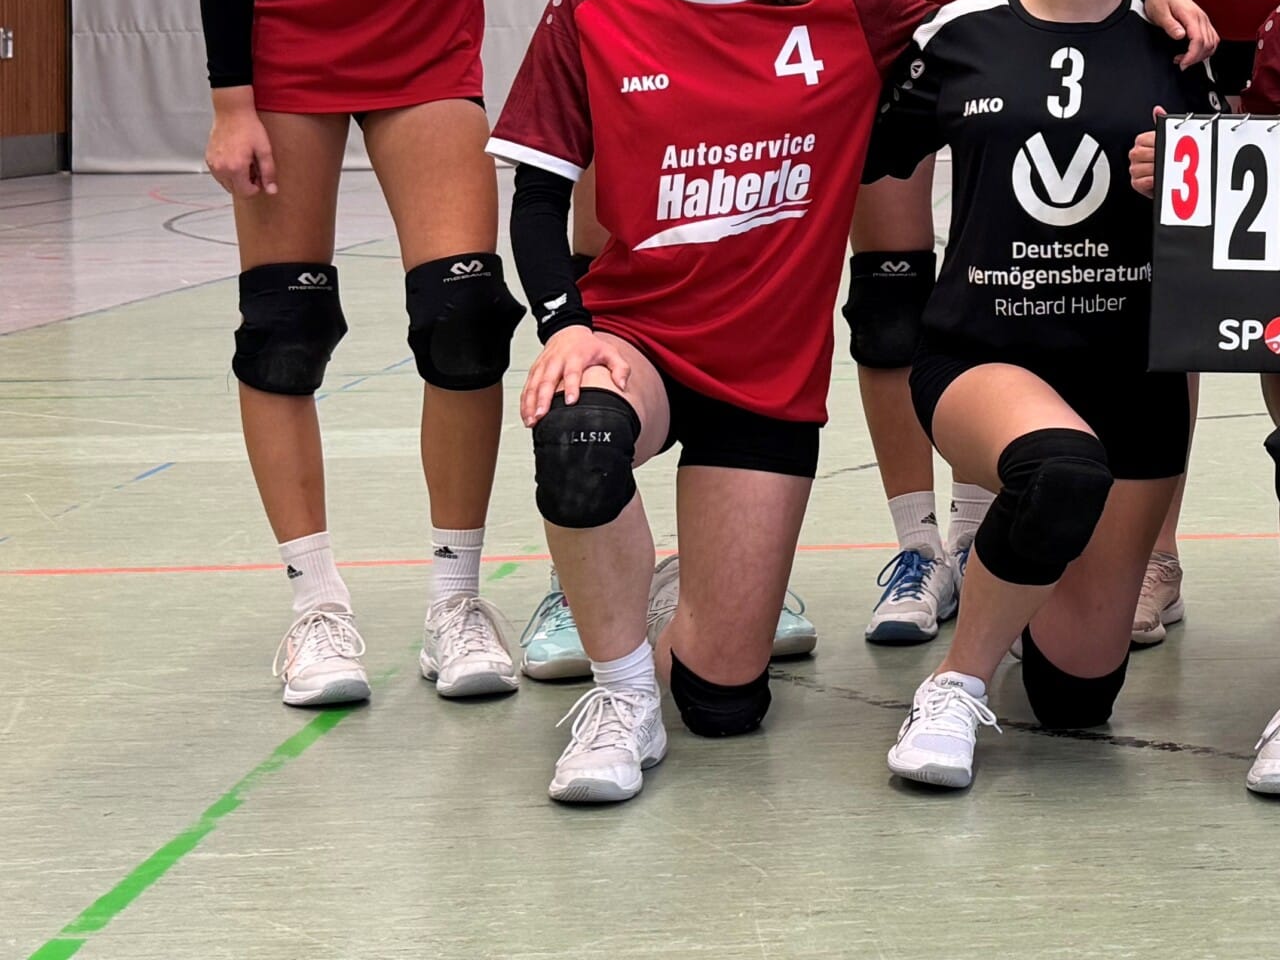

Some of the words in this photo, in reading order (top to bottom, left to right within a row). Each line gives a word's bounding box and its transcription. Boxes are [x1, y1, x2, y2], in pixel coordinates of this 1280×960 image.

[773, 25, 825, 86] 4
[620, 73, 670, 94] JAKO
[1046, 46, 1086, 119] 3
[962, 97, 1004, 117] JAKO
[662, 133, 816, 171] Autoservice
[656, 158, 812, 222] Haberle
[1171, 135, 1201, 221] 3
[1012, 239, 1110, 259] Deutsche
[995, 295, 1066, 317] Richard
[1071, 294, 1127, 314] Huber
[561, 430, 612, 444] LLSIX
